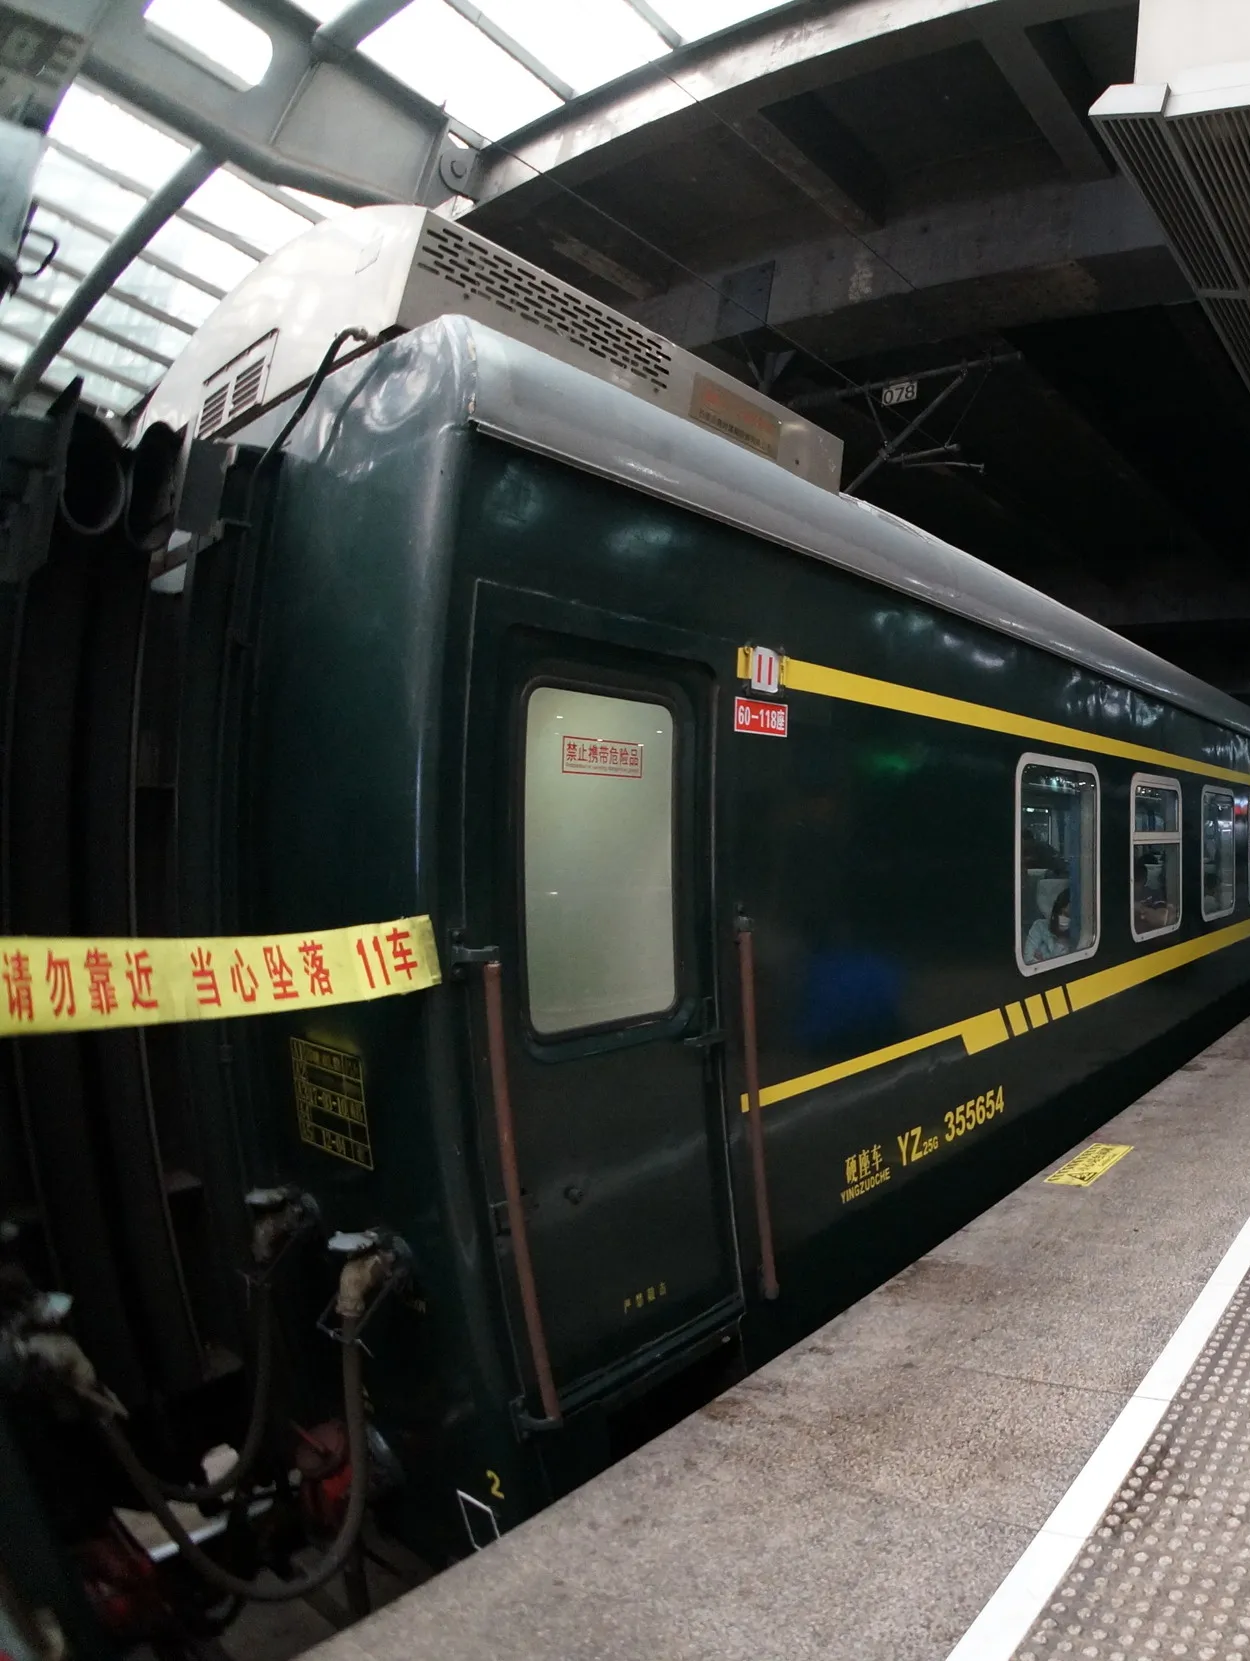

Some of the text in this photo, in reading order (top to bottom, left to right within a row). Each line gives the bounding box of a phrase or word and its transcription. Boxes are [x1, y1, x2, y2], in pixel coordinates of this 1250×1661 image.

[883, 384, 916, 405] 078
[756, 654, 774, 686] 11
[737, 705, 785, 731] 60-118座
[566, 742, 640, 767] 禁止携带危险品
[3, 927, 420, 1023] 请勿靠近 当心坠落 11车
[944, 1085, 1005, 1142] 355654
[845, 1144, 883, 1184] 硬座车
[840, 1167, 891, 1204] YINGZUOCHE
[485, 1469, 505, 1499] 2
